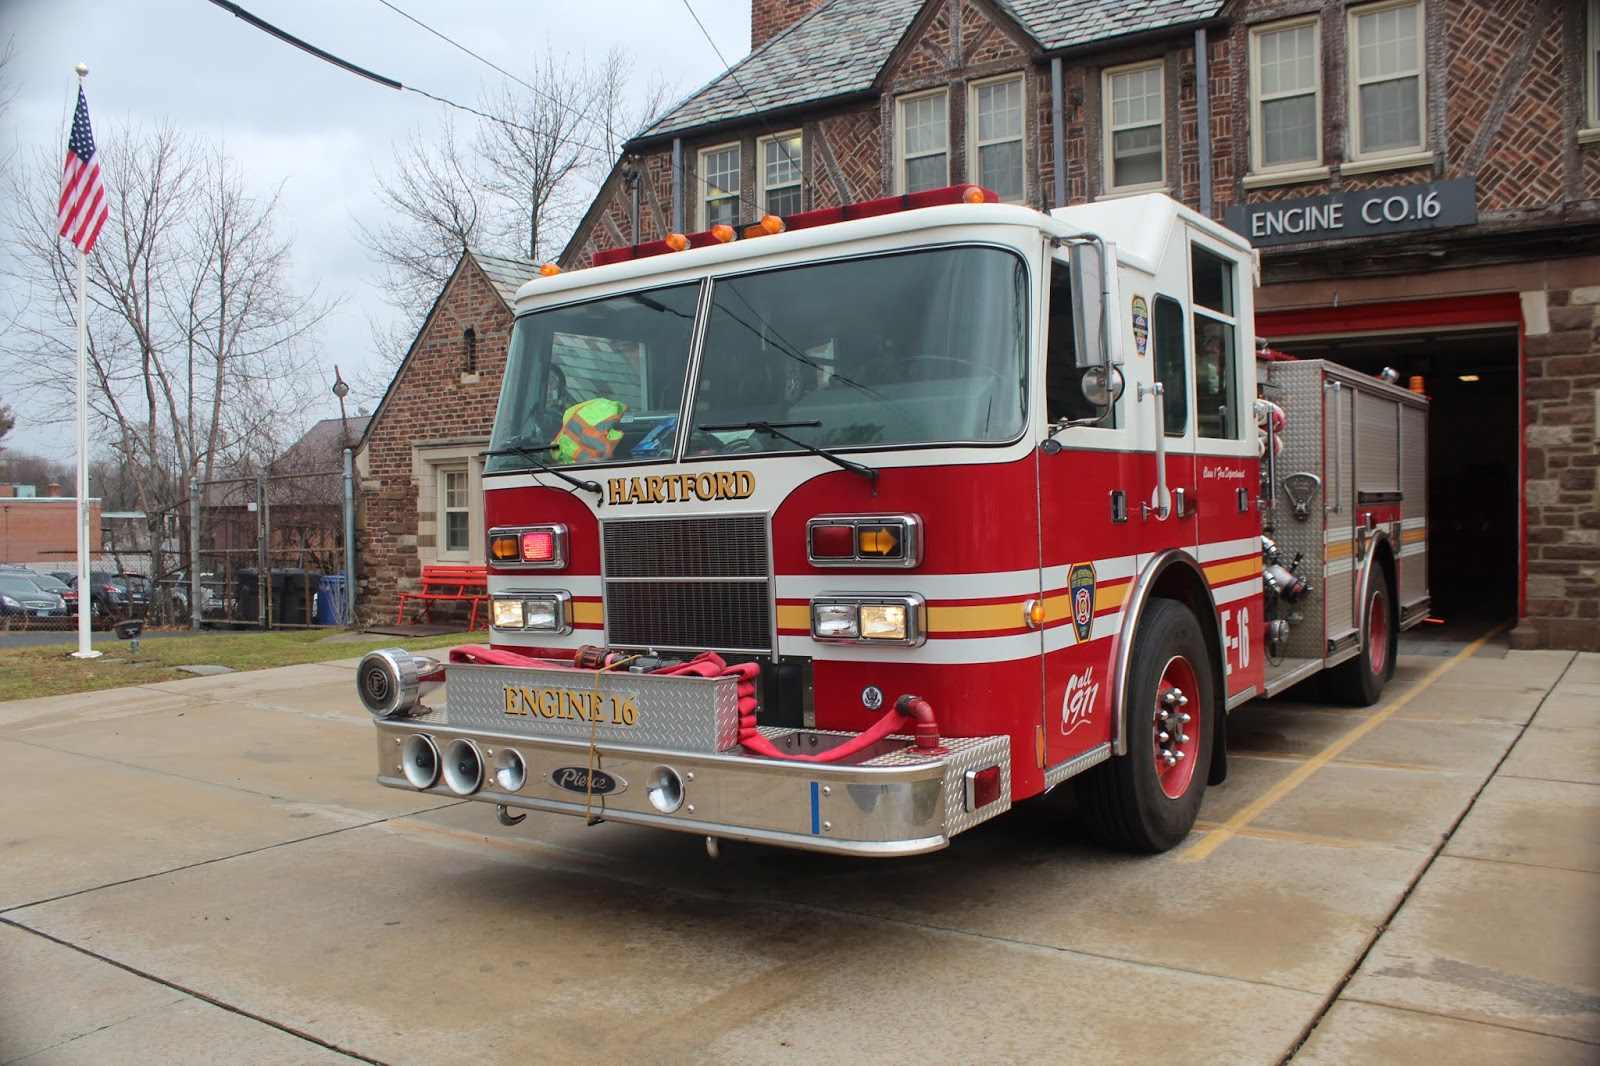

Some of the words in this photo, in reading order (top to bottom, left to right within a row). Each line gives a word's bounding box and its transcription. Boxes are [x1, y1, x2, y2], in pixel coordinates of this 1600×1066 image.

[1252, 203, 1344, 237] ENGINE
[1361, 191, 1441, 224] CO.16
[608, 470, 756, 505] HARTFORD
[1220, 606, 1250, 676] E-16
[503, 685, 606, 722] ENGINE
[611, 695, 638, 725] 16
[1069, 682, 1099, 725] 911
[560, 768, 607, 789] Piece
